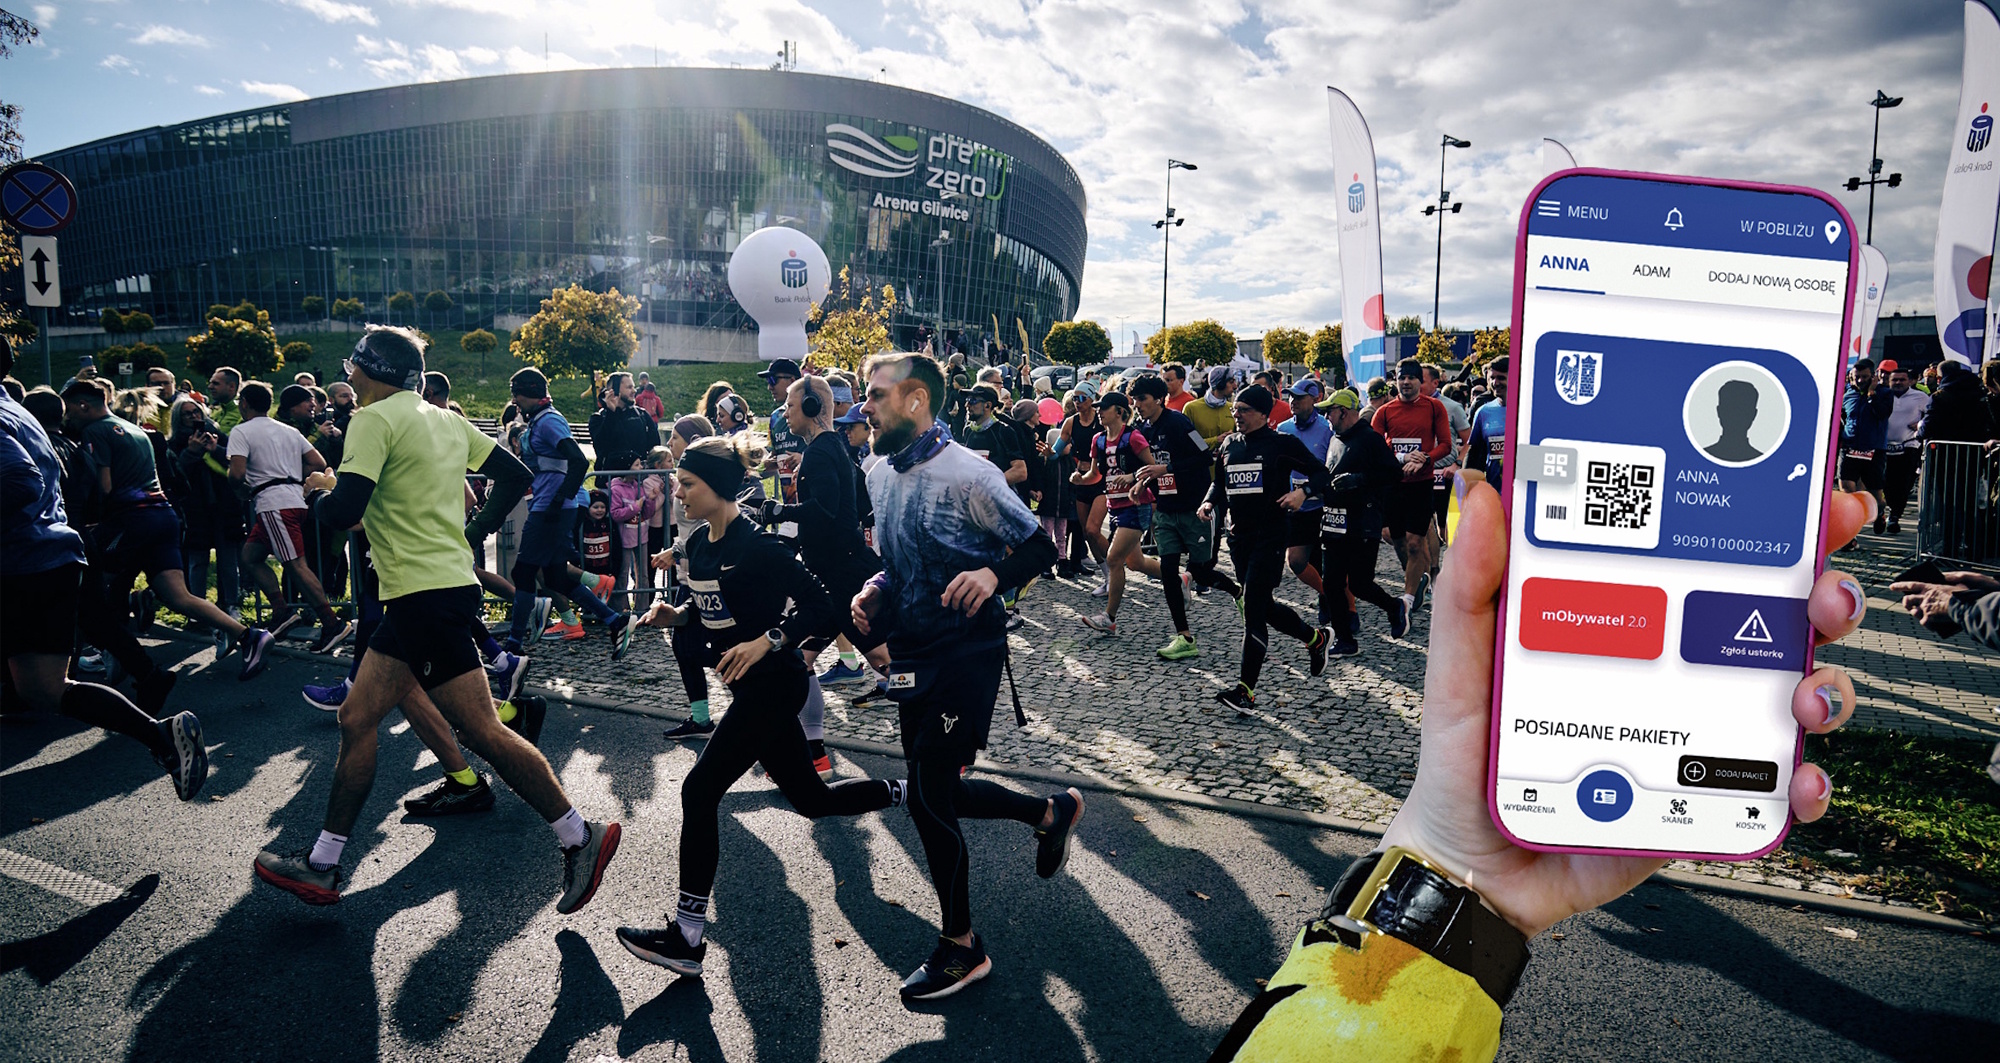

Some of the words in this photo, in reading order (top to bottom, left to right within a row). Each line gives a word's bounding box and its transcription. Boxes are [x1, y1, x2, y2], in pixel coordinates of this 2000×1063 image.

[928, 136, 973, 164] pre
[926, 167, 986, 198] zero
[873, 193, 919, 213] Arena
[921, 201, 969, 221] Gliwice
[1567, 205, 1609, 220] MENU
[1740, 220, 1754, 232] W
[1757, 221, 1815, 238] POBLIŻU
[1539, 255, 1590, 272] ANNA
[1632, 264, 1671, 278] ADAM
[1708, 270, 1750, 284] DODAJ
[1752, 275, 1791, 291] NOWĄ
[1794, 278, 1836, 295] OSOBĘ
[774, 295, 792, 303] Bank
[381, 365, 397, 374] BAY
[1393, 444, 1420, 452] 10472
[1229, 471, 1260, 484] 10087
[1676, 469, 1720, 485] ANNA
[1675, 491, 1732, 508] NOWAK
[588, 544, 605, 554] 315
[1672, 534, 1791, 555] 9090100002347
[1542, 610, 1624, 626] mObywatel
[1628, 615, 1647, 629] 2.0
[1720, 646, 1747, 657] Zgłoś
[1748, 649, 1785, 660] usterkę
[1514, 718, 1614, 741] POSIADANE
[1619, 727, 1691, 746] PAKIETY
[1715, 769, 1741, 779] DODAJ
[1741, 771, 1769, 781] PAKIET
[1503, 803, 1556, 814] WYDARZENIA
[1661, 815, 1694, 825] SKANER
[1735, 821, 1767, 831] KOSZYK
